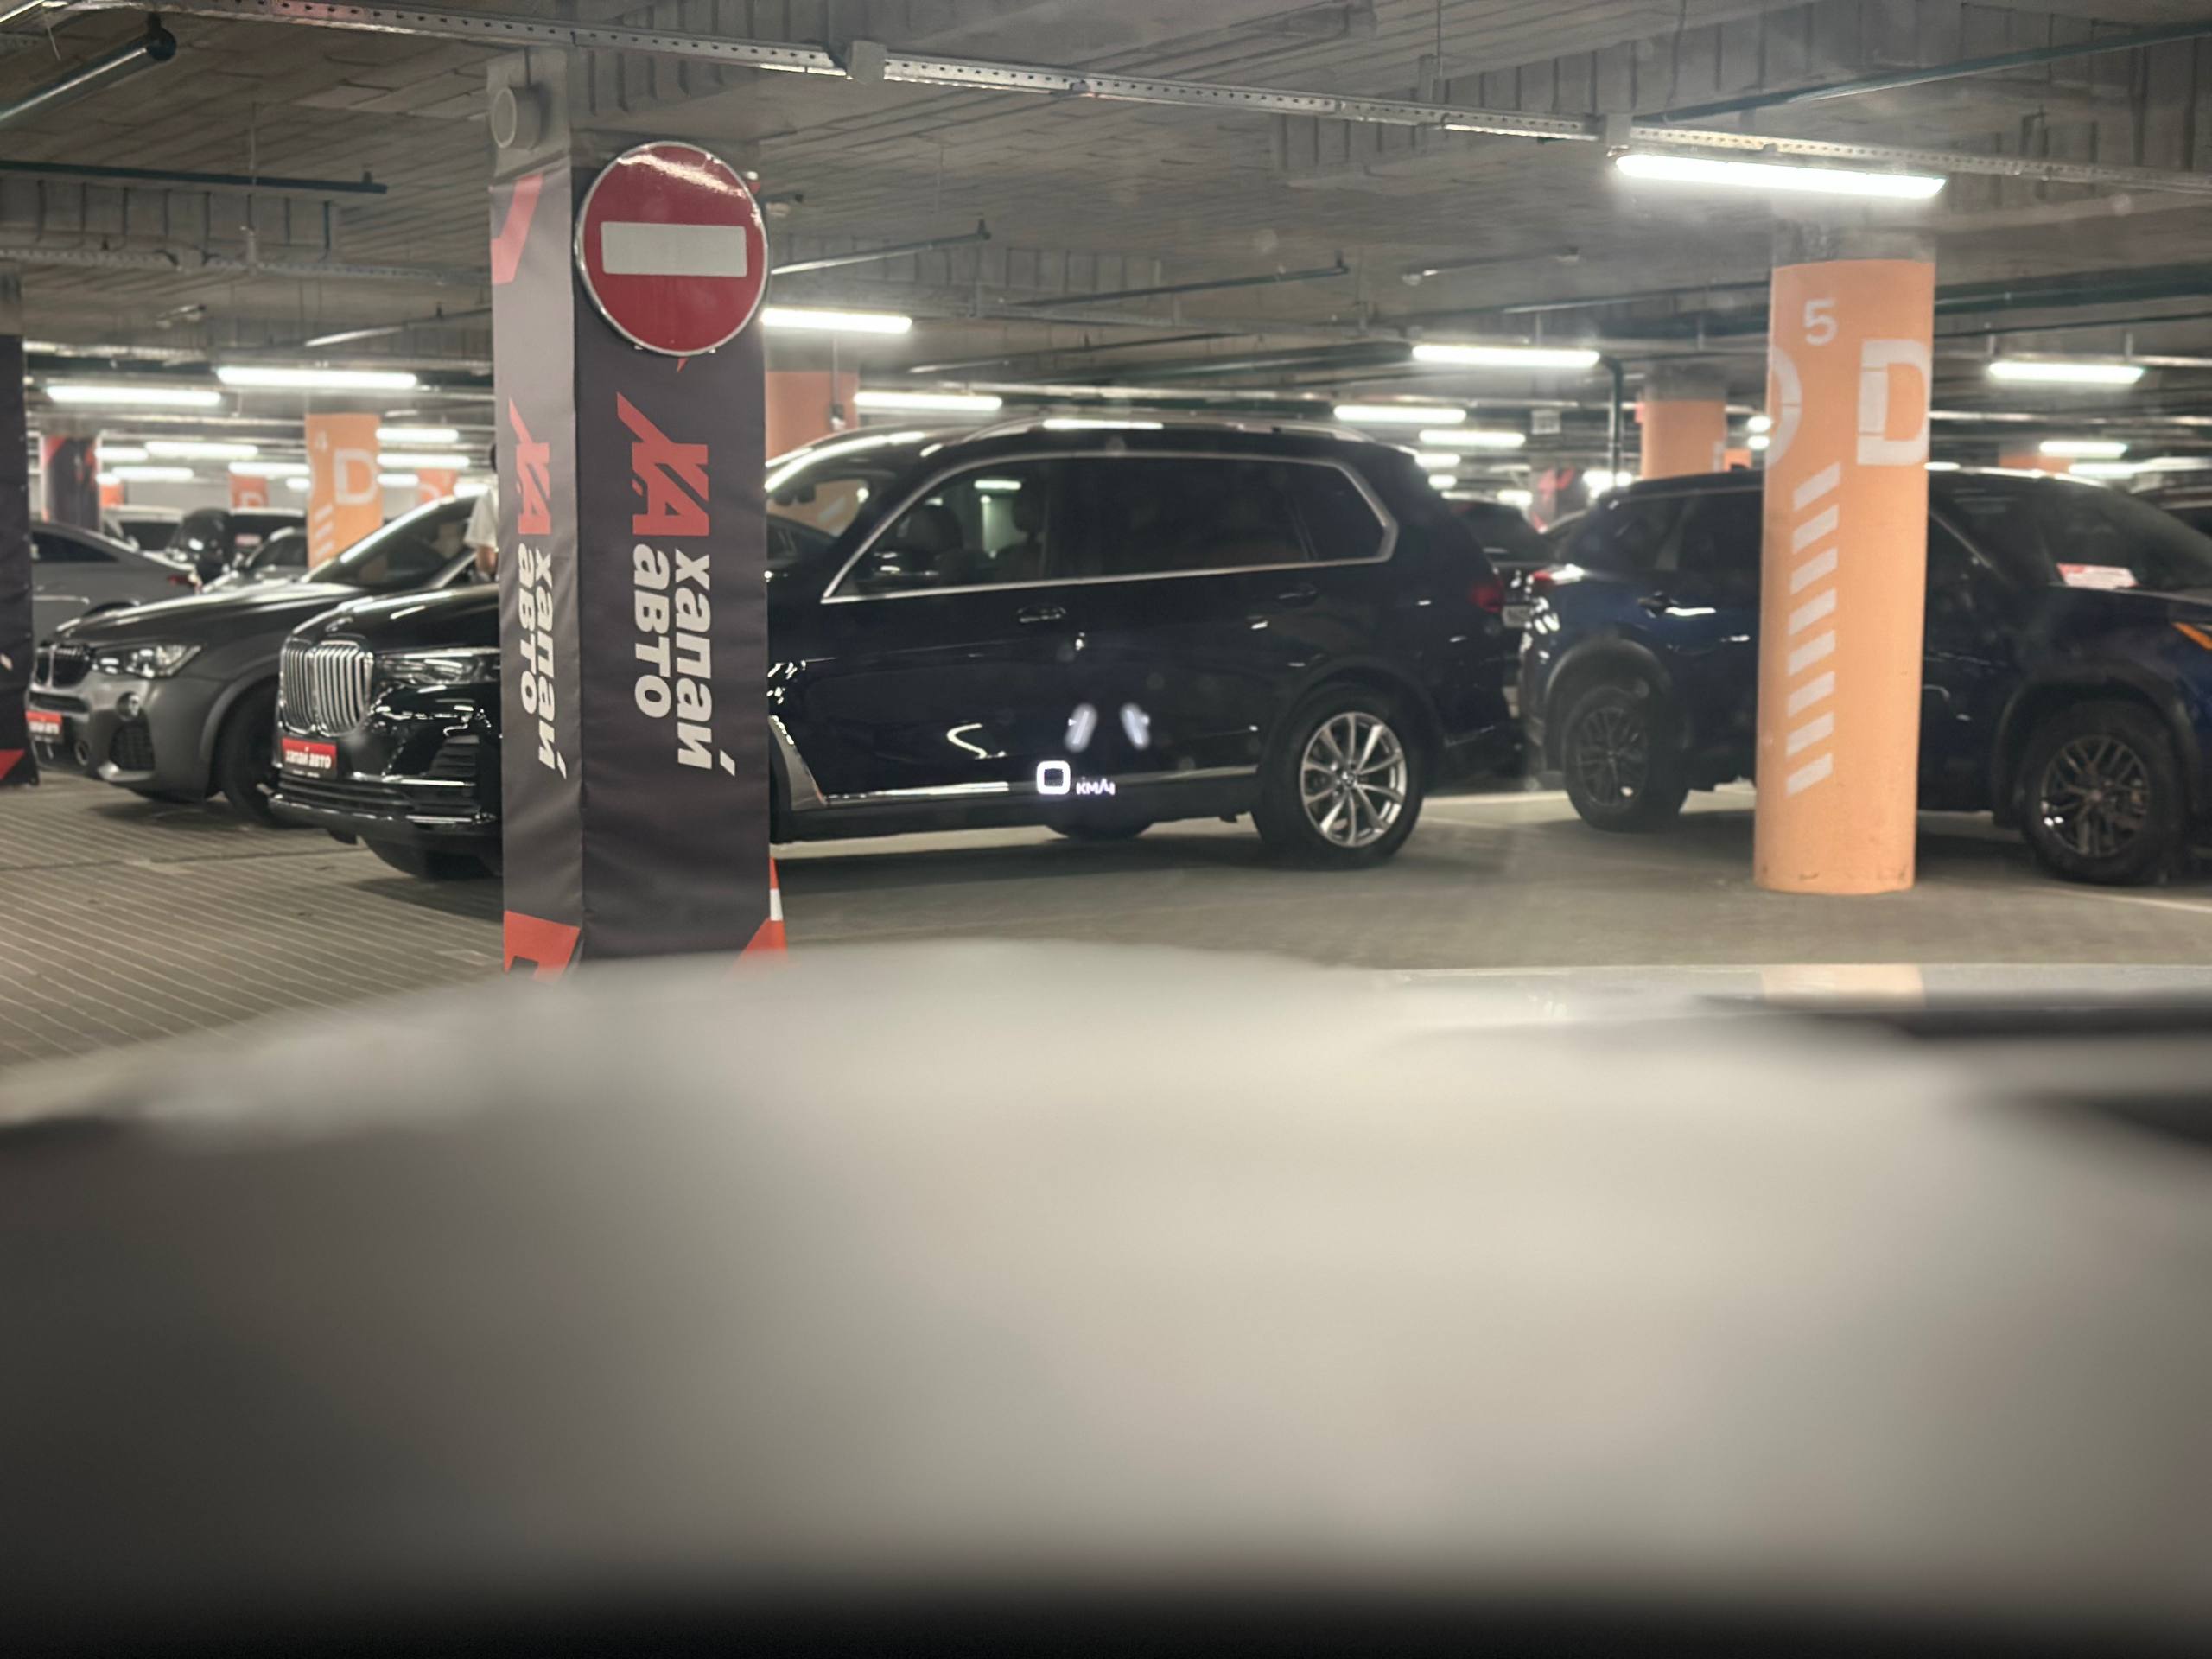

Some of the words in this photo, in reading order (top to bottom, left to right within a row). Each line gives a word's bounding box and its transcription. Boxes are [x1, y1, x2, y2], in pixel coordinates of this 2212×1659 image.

[1802, 298, 1837, 344] 5
[1856, 340, 1932, 465] D
[333, 448, 379, 505] D
[633, 543, 672, 719] авто
[676, 548, 735, 776] хапай
